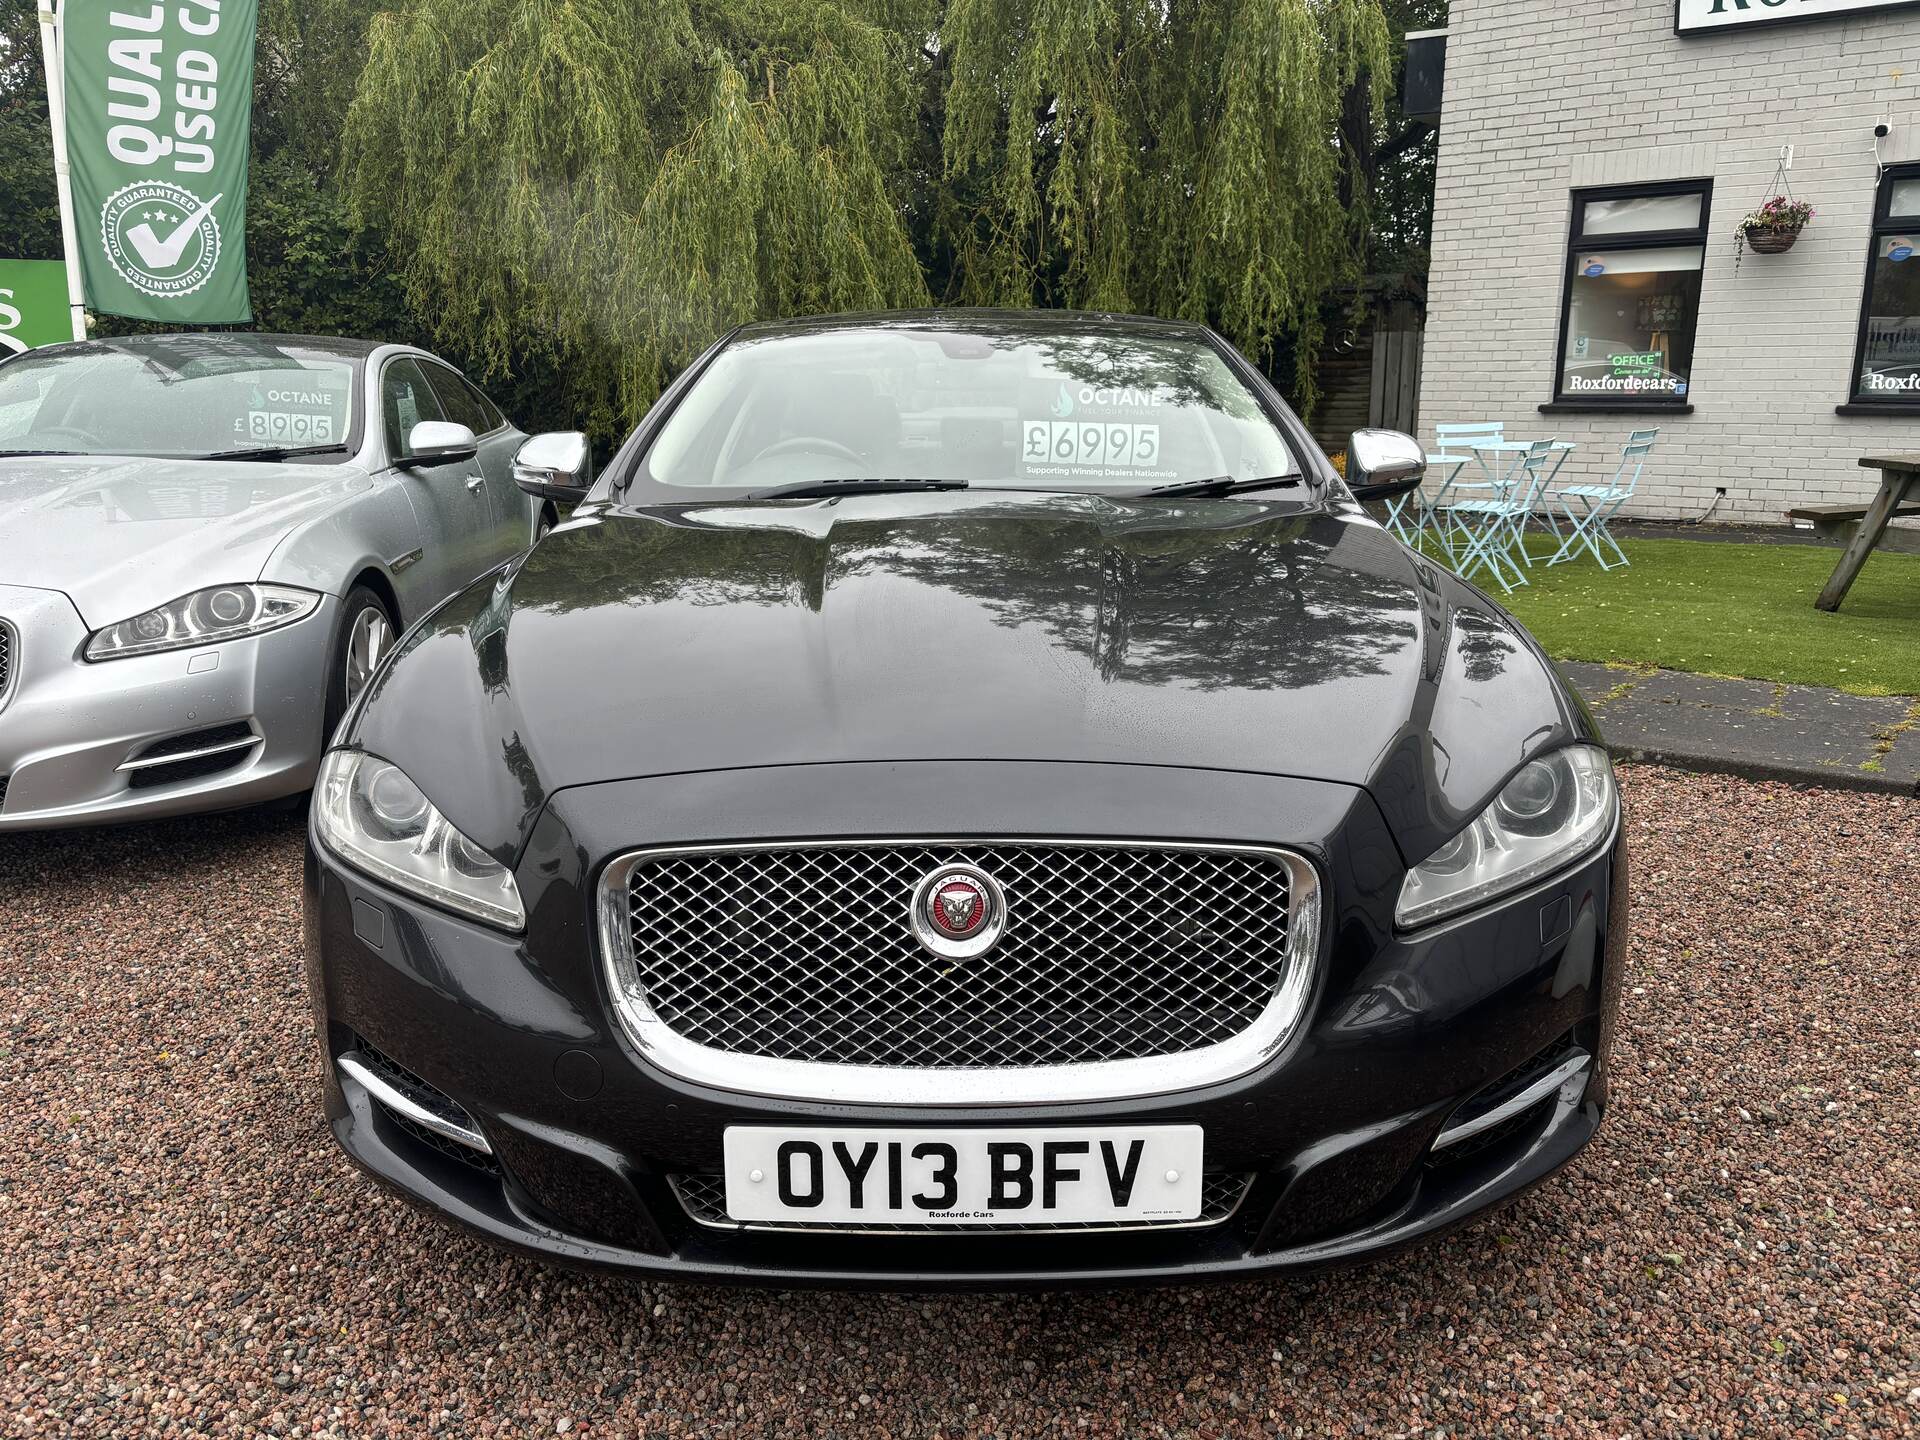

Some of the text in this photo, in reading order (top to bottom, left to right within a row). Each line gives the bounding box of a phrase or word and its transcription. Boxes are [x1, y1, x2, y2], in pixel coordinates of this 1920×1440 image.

[175, 50, 218, 173] USED
[107, 188, 196, 257] QUALITY GUARANTEED
[127, 222, 215, 290] QUALITY GUARANTEED
[1612, 354, 1655, 366] OFFICE
[1570, 374, 1677, 390] Roxfordecars
[268, 390, 332, 405] OCTANE
[1079, 387, 1161, 407] OCTANE
[1026, 426, 1155, 459] £6995
[1026, 466, 1177, 478] Supporting Winning Dealers Nationwide
[934, 876, 985, 894] JAGUAR
[777, 1140, 1145, 1210] OY13 BFV
